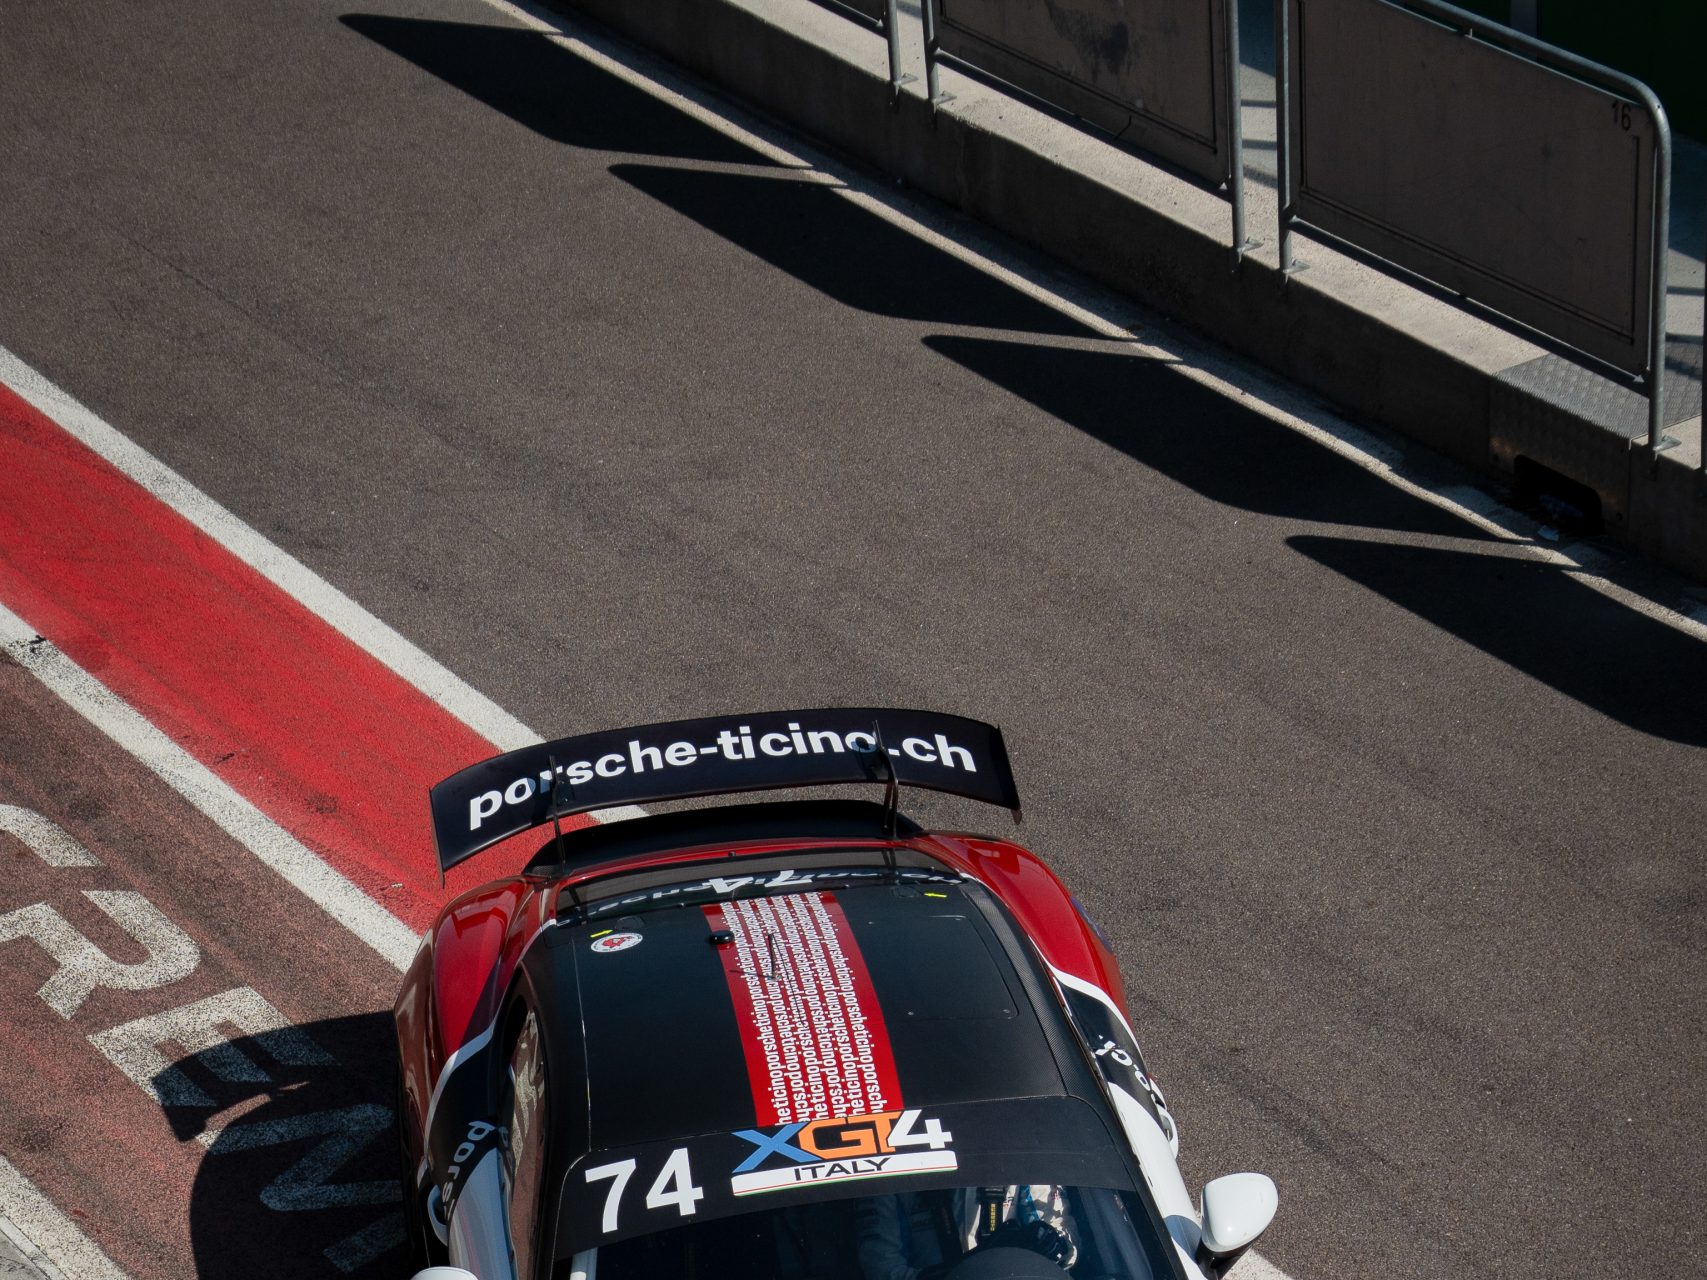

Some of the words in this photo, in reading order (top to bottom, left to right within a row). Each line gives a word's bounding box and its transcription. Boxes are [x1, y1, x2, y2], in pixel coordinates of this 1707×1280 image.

[1612, 101, 1631, 130] 16
[470, 722, 977, 830] porsche-ticino.ch
[731, 1109, 953, 1174] XGT4
[793, 1157, 891, 1182] ITALY
[585, 1147, 704, 1234] 74
